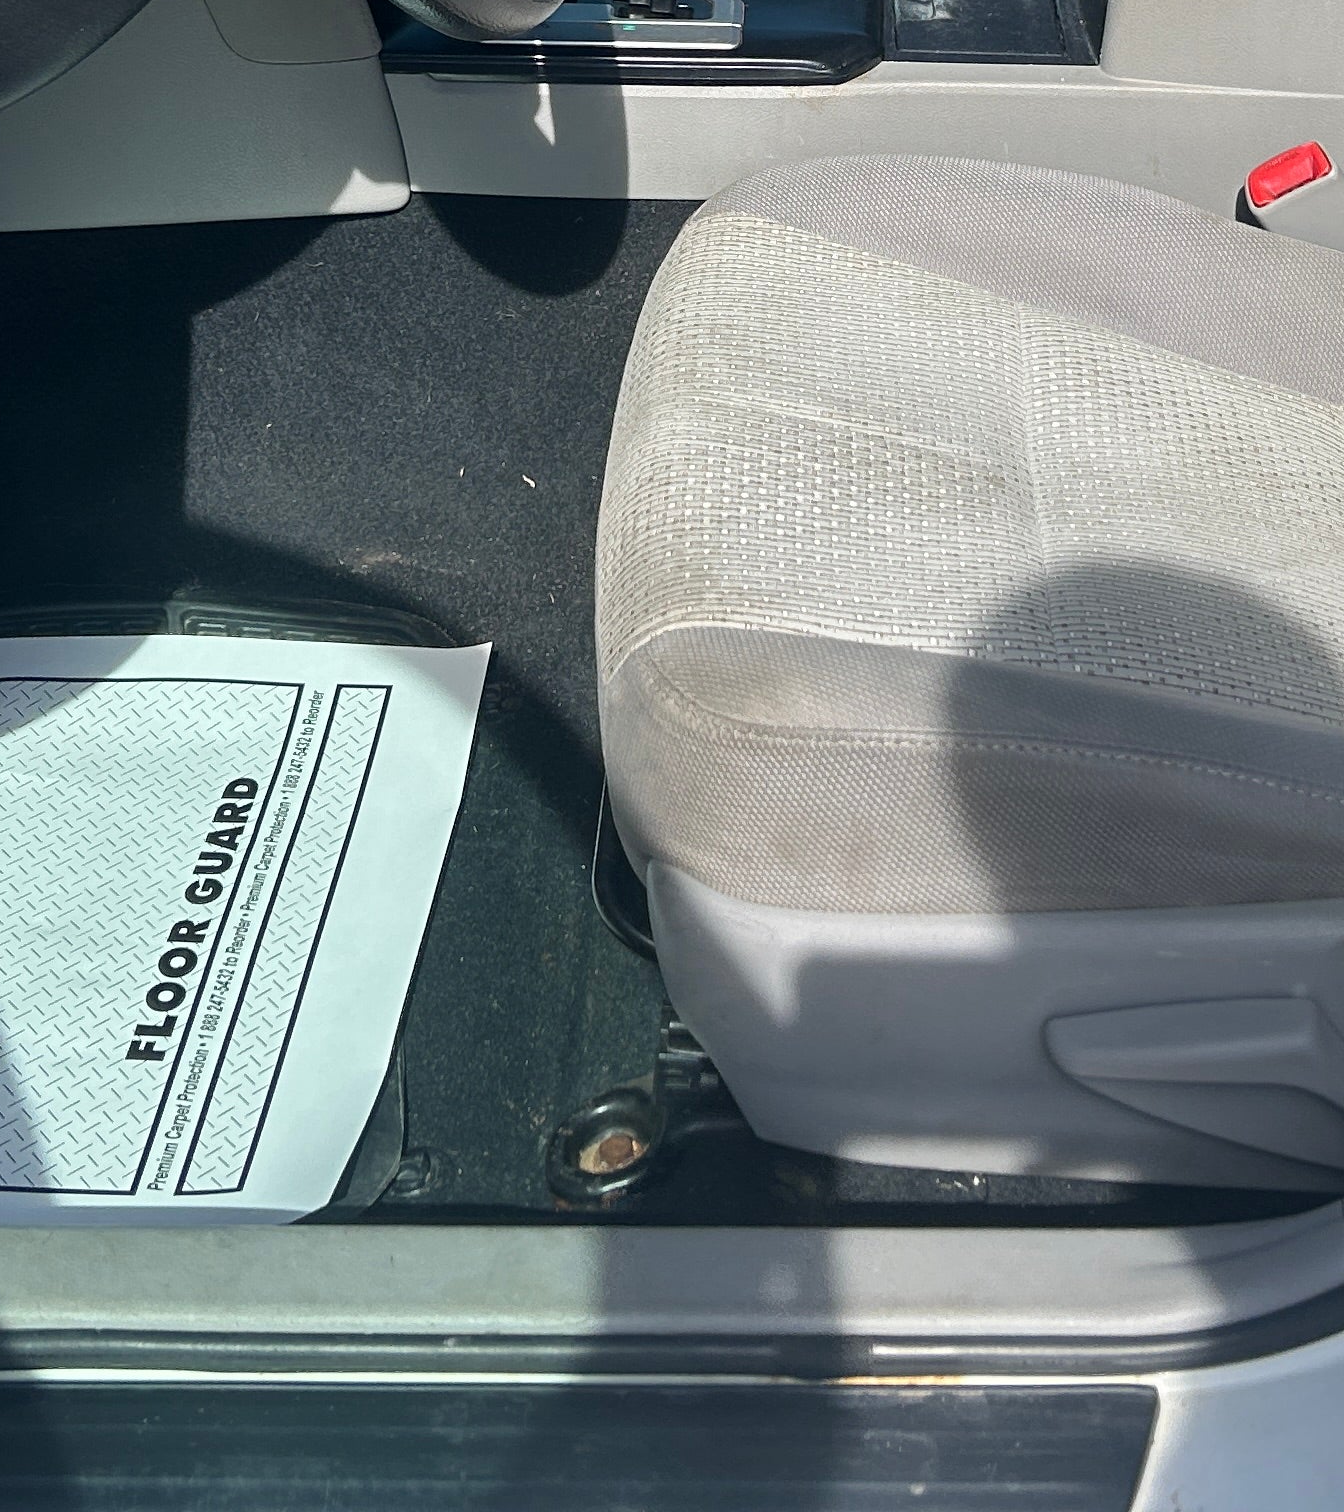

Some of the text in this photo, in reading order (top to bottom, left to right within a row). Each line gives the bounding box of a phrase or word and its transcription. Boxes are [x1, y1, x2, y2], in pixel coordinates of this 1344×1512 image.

[302, 690, 324, 725] Reorder
[300, 727, 314, 735] to
[264, 801, 291, 842] Protection
[254, 844, 277, 870] Carpet
[240, 872, 267, 911] Premium
[124, 777, 259, 1061] FLOOR GUARD
[225, 918, 251, 955] Reorder
[223, 956, 238, 966] to
[207, 968, 235, 1012] 247-5432
[176, 1049, 210, 1102] Protection
[164, 1104, 191, 1139] Carpet
[147, 1142, 178, 1191] Premium
